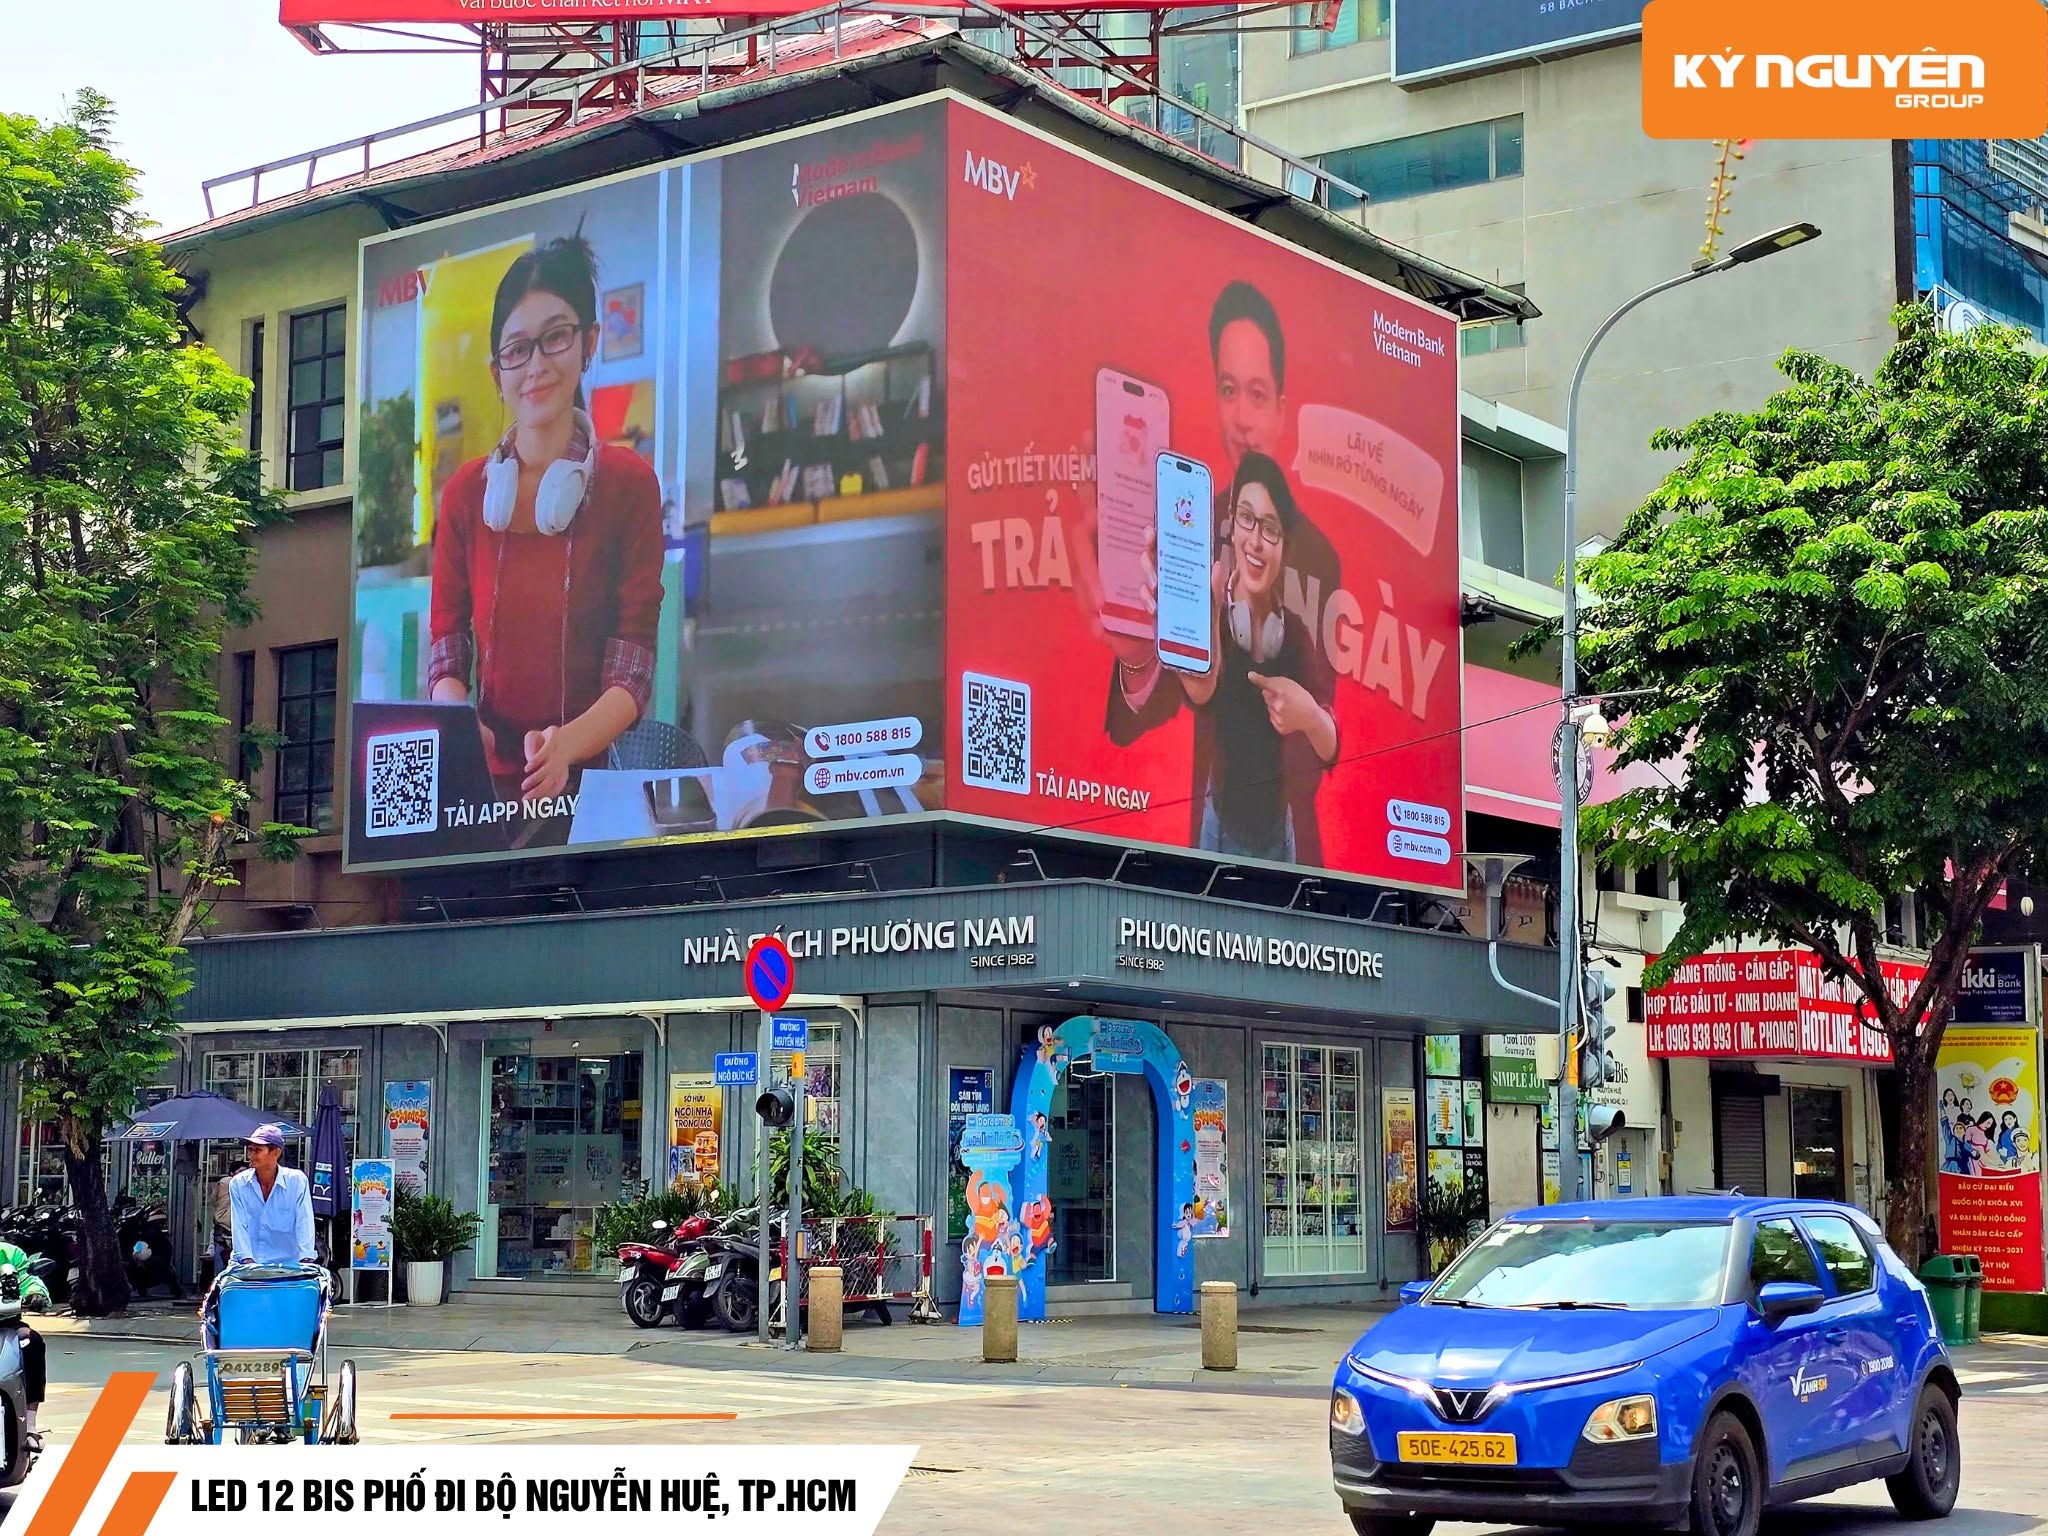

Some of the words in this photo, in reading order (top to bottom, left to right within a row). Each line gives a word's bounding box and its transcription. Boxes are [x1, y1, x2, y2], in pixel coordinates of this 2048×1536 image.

[1540, 4, 1555, 14] 58
[964, 150, 1020, 201] MBV
[792, 176, 878, 207] Vietnam
[379, 266, 436, 307] MBV
[1373, 310, 1445, 357] ModernBank
[1373, 333, 1422, 368] Vietnam
[967, 451, 1002, 491] GỬI
[1005, 441, 1046, 484] TIẾT
[1049, 446, 1098, 490] KIỆM
[1336, 455, 1351, 474] RÕ
[1390, 482, 1424, 521] NGÀY
[971, 488, 1074, 593] TRẢ
[1283, 566, 1446, 722] NGÀY
[834, 733, 862, 747] 1800
[866, 730, 888, 743] 588
[891, 727, 911, 740] 815
[834, 765, 905, 784] mbv.com.vn
[1035, 767, 1064, 798] TẢI
[1066, 780, 1102, 803] APP
[1104, 786, 1151, 812] NGAY
[444, 799, 474, 827] TẢI
[478, 803, 517, 825] APP
[523, 794, 581, 820] NGAY
[1404, 810, 1419, 821] 1800
[1421, 813, 1433, 823] 588
[1434, 816, 1445, 826] 815
[1404, 841, 1442, 856] mbv.com.vn
[684, 928, 741, 965] NHÀ
[832, 919, 955, 955] PHƯƠNG
[964, 915, 1034, 948] NAM
[1121, 917, 1211, 956] PHUONG
[1216, 931, 1263, 963] NAM
[1267, 937, 1383, 978] BOOKSTORE
[970, 954, 1005, 968] SINCE
[1008, 954, 1035, 966] 1982
[1119, 955, 1144, 968] SINCE
[1145, 958, 1165, 971] 1982
[1702, 957, 1736, 983] TRỐNG
[1745, 955, 1767, 981] CẦN
[1769, 954, 1794, 980] GẤP:
[1800, 960, 1817, 1006] MẶT
[1998, 979, 2021, 988] Bank
[1647, 994, 1667, 1019] HỢP
[1669, 992, 1688, 1014] TÁC
[1690, 988, 1711, 1014] ĐẦU
[1713, 992, 1727, 1013] TƯ
[1735, 993, 1760, 1012] KINH
[1763, 992, 1798, 1011] DOANH
[780, 1022, 800, 1031] ĐƯỜNG
[1801, 1009, 1857, 1055] HOTLINE:
[795, 1035, 805, 1047] HUỆ
[1648, 1024, 1664, 1051] LH:
[1666, 1023, 1690, 1051] 0903
[1692, 1023, 1710, 1051] 938
[1713, 1022, 1731, 1050] 993
[1741, 1022, 1757, 1049] Mr.
[1759, 1021, 1798, 1052] PHONG)
[724, 1056, 748, 1066] ĐƯỜNG
[718, 1069, 731, 1081] NGÔ
[732, 1068, 744, 1081] ĐỨC
[745, 1067, 755, 1080] KẾ
[1492, 1071, 1527, 1087] SIMPLE
[1615, 1061, 1628, 1083] Bis
[675, 1105, 694, 1117] NGÔI
[696, 1105, 712, 1116] NHÀ
[675, 1119, 698, 1128] TRONG
[978, 1116, 1012, 1127] Doraemon
[1952, 1197, 1971, 1205] QUỐC
[1973, 1198, 1985, 1206] HỘI
[1989, 1214, 2002, 1223] HỘI
[2004, 1214, 2027, 1223] ĐỒNG
[2007, 1230, 2023, 1238] CẤP
[1952, 1245, 1972, 1253] NHIỆM
[1996, 1262, 2009, 1270] HỘI
[1868, 1359, 1880, 1373] 1900
[1801, 1380, 1818, 1395] XANH
[1409, 1440, 1506, 1458] 50E-425.62
